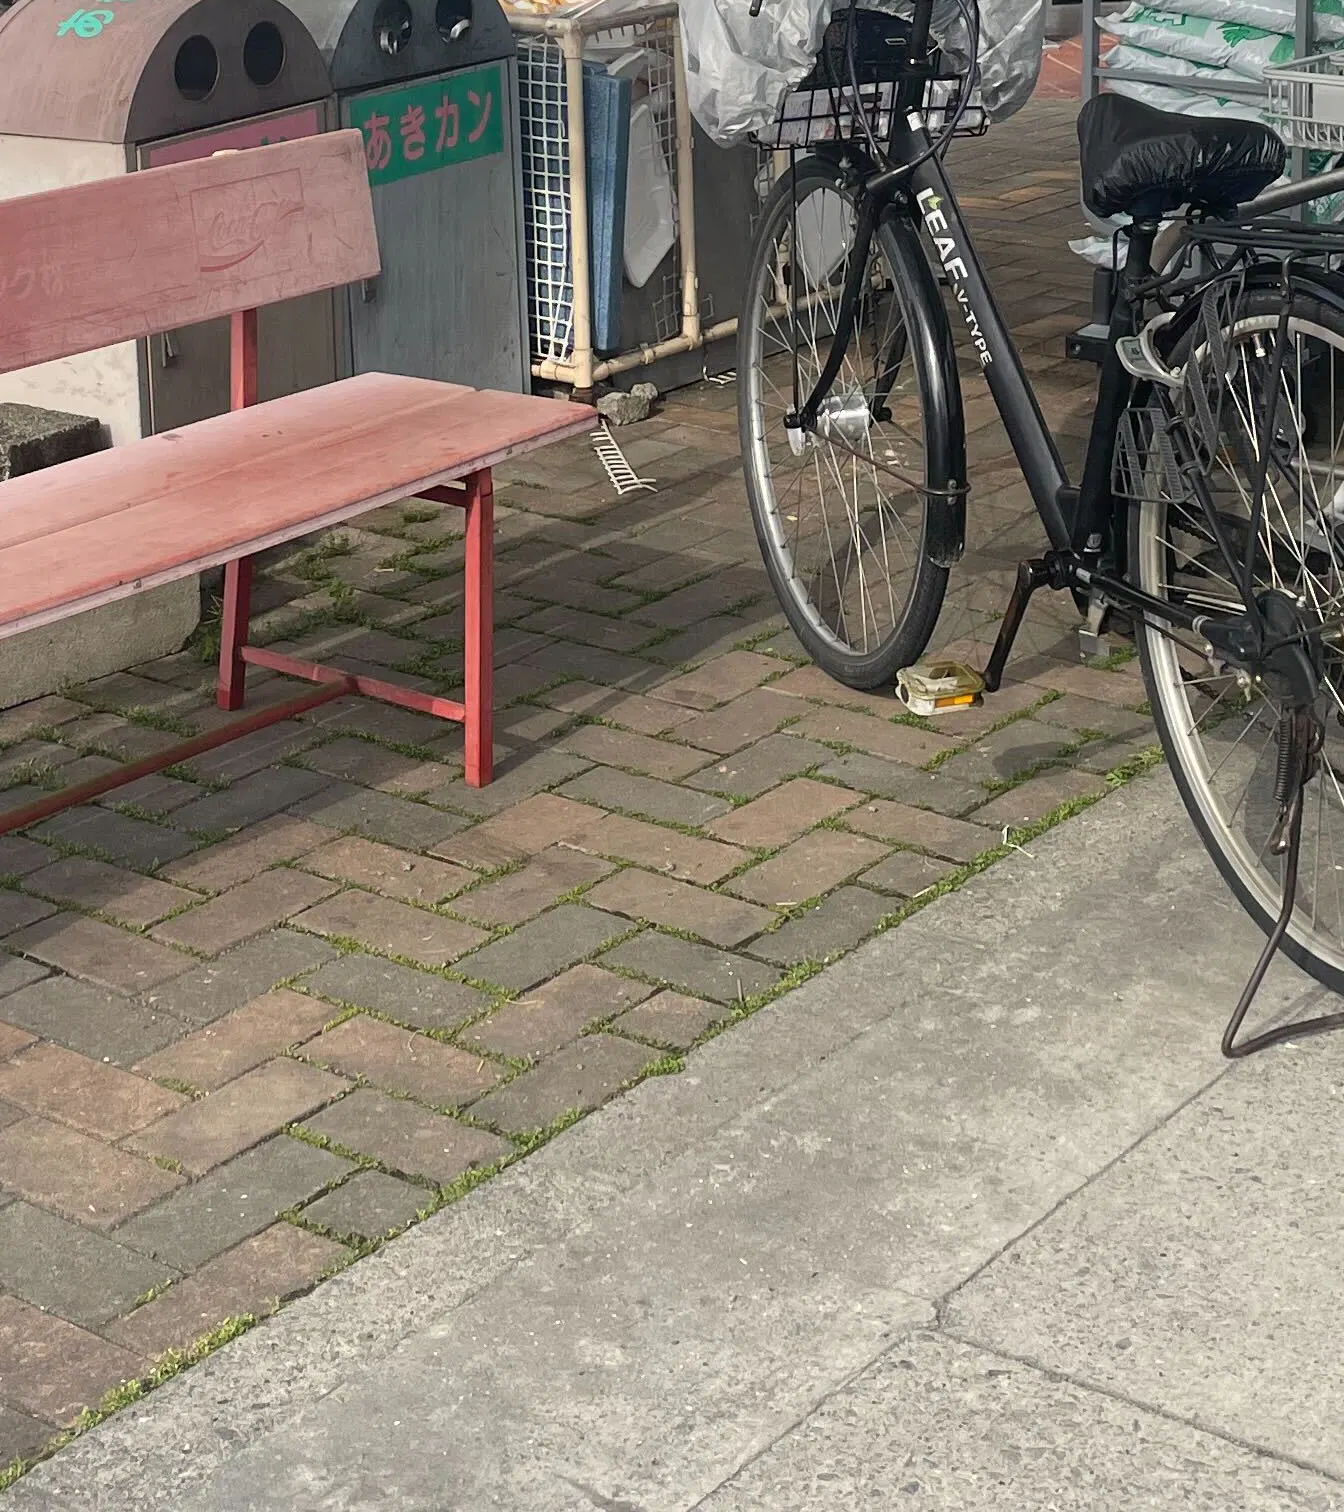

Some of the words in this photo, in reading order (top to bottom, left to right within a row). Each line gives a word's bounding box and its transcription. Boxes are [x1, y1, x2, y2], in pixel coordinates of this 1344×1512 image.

[363, 89, 493, 171] あきカン
[916, 188, 969, 283] LEAF
[955, 288, 994, 367] V-TYPE
